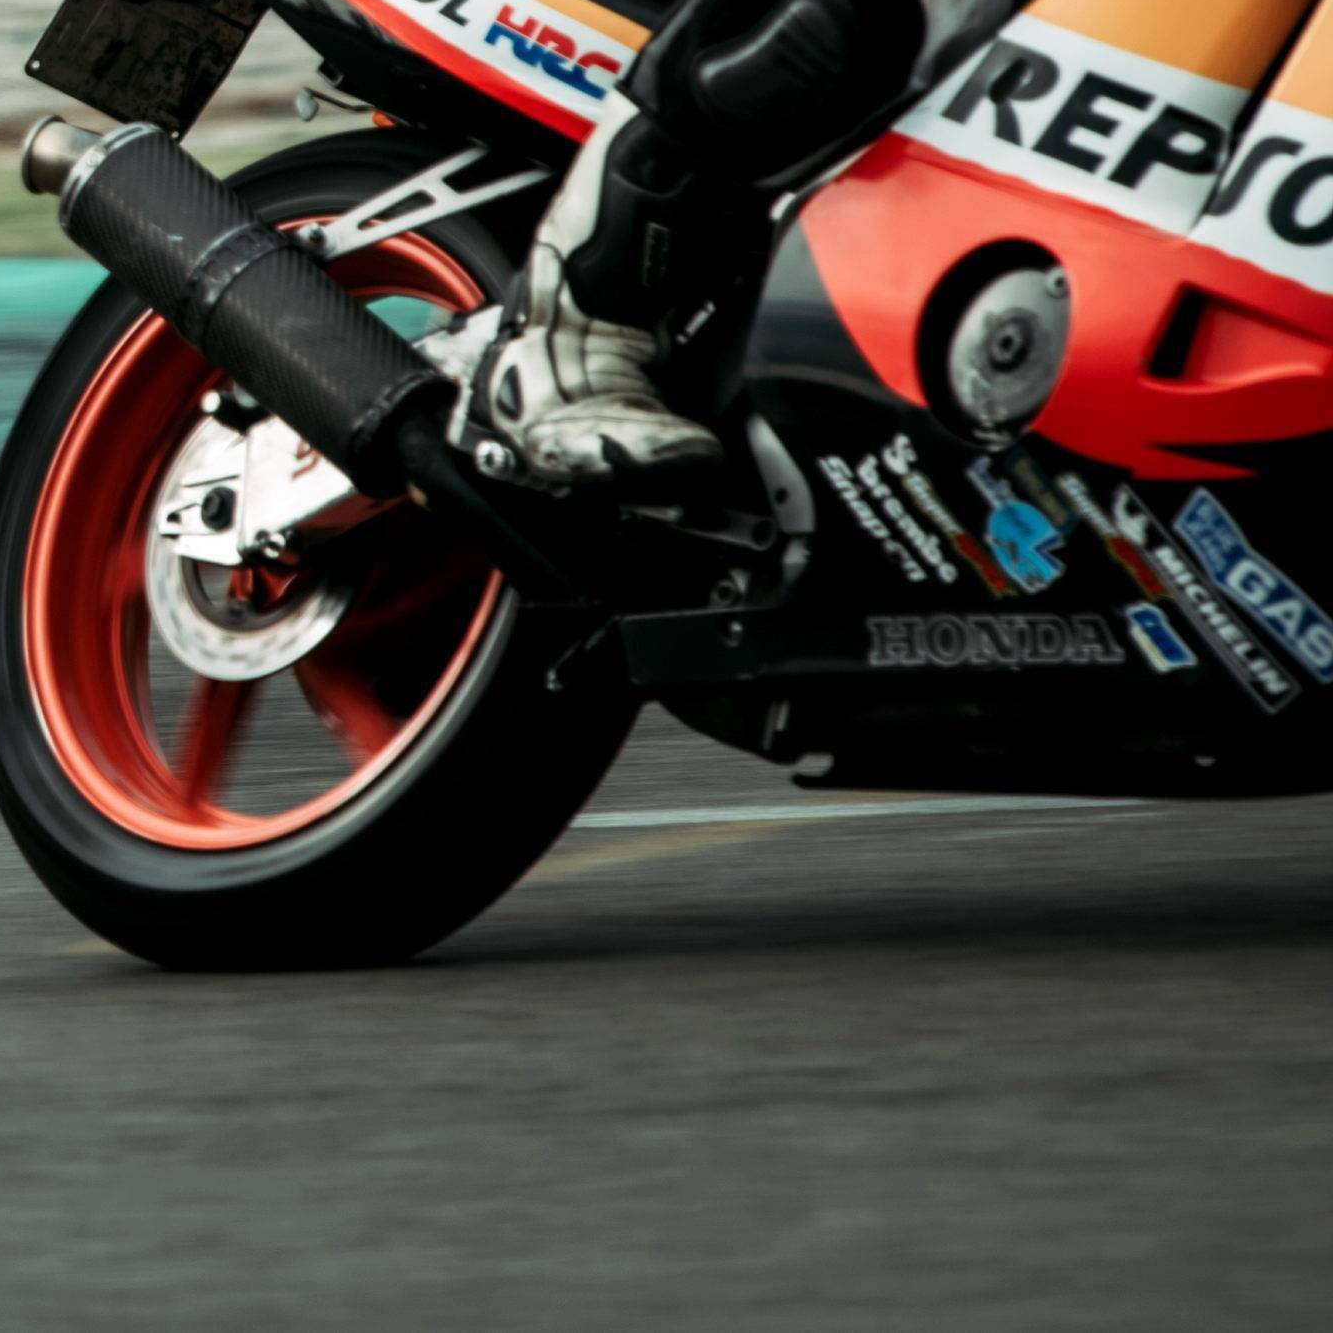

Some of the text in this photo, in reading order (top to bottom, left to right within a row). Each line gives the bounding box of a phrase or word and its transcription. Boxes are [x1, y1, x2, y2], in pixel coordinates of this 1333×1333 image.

[484, 3, 623, 101] HRC
[856, 453, 959, 584] brembo
[864, 612, 1128, 667] HONDA
[1154, 545, 1289, 695] MICHELIN
